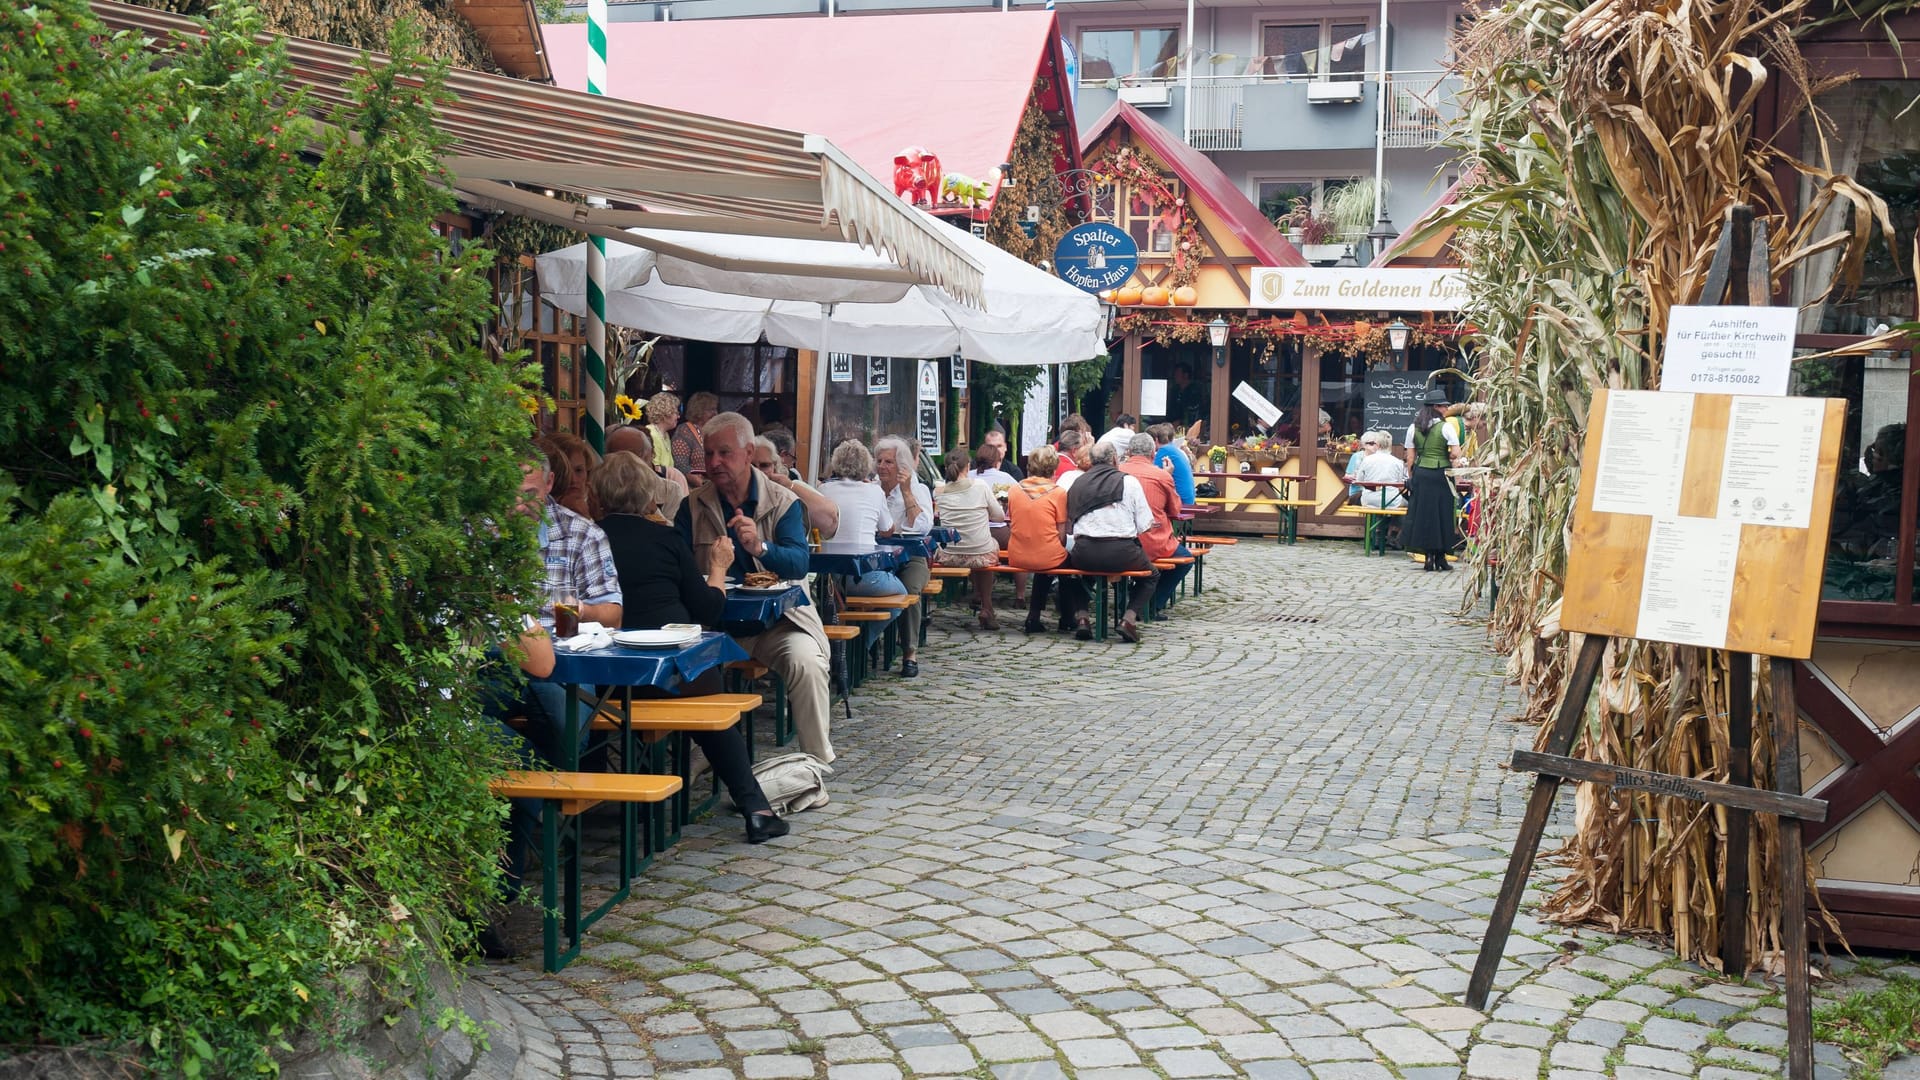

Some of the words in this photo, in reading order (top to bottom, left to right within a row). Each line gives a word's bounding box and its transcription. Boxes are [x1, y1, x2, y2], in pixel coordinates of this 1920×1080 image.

[1073, 228, 1121, 247] Spalter
[1065, 264, 1129, 288] Hopfen-Haus
[1292, 279, 1330, 297] Zum
[1338, 279, 1422, 297] Goldenen
[1709, 319, 1759, 329] Aushilfen
[1677, 331, 1692, 340] für
[1694, 331, 1731, 341] Fürther
[1734, 332, 1787, 342] Kirchweih
[1701, 350, 1742, 360] gesucht
[1690, 373, 1760, 384] 0178-8150082
[1615, 771, 1645, 786] Altes
